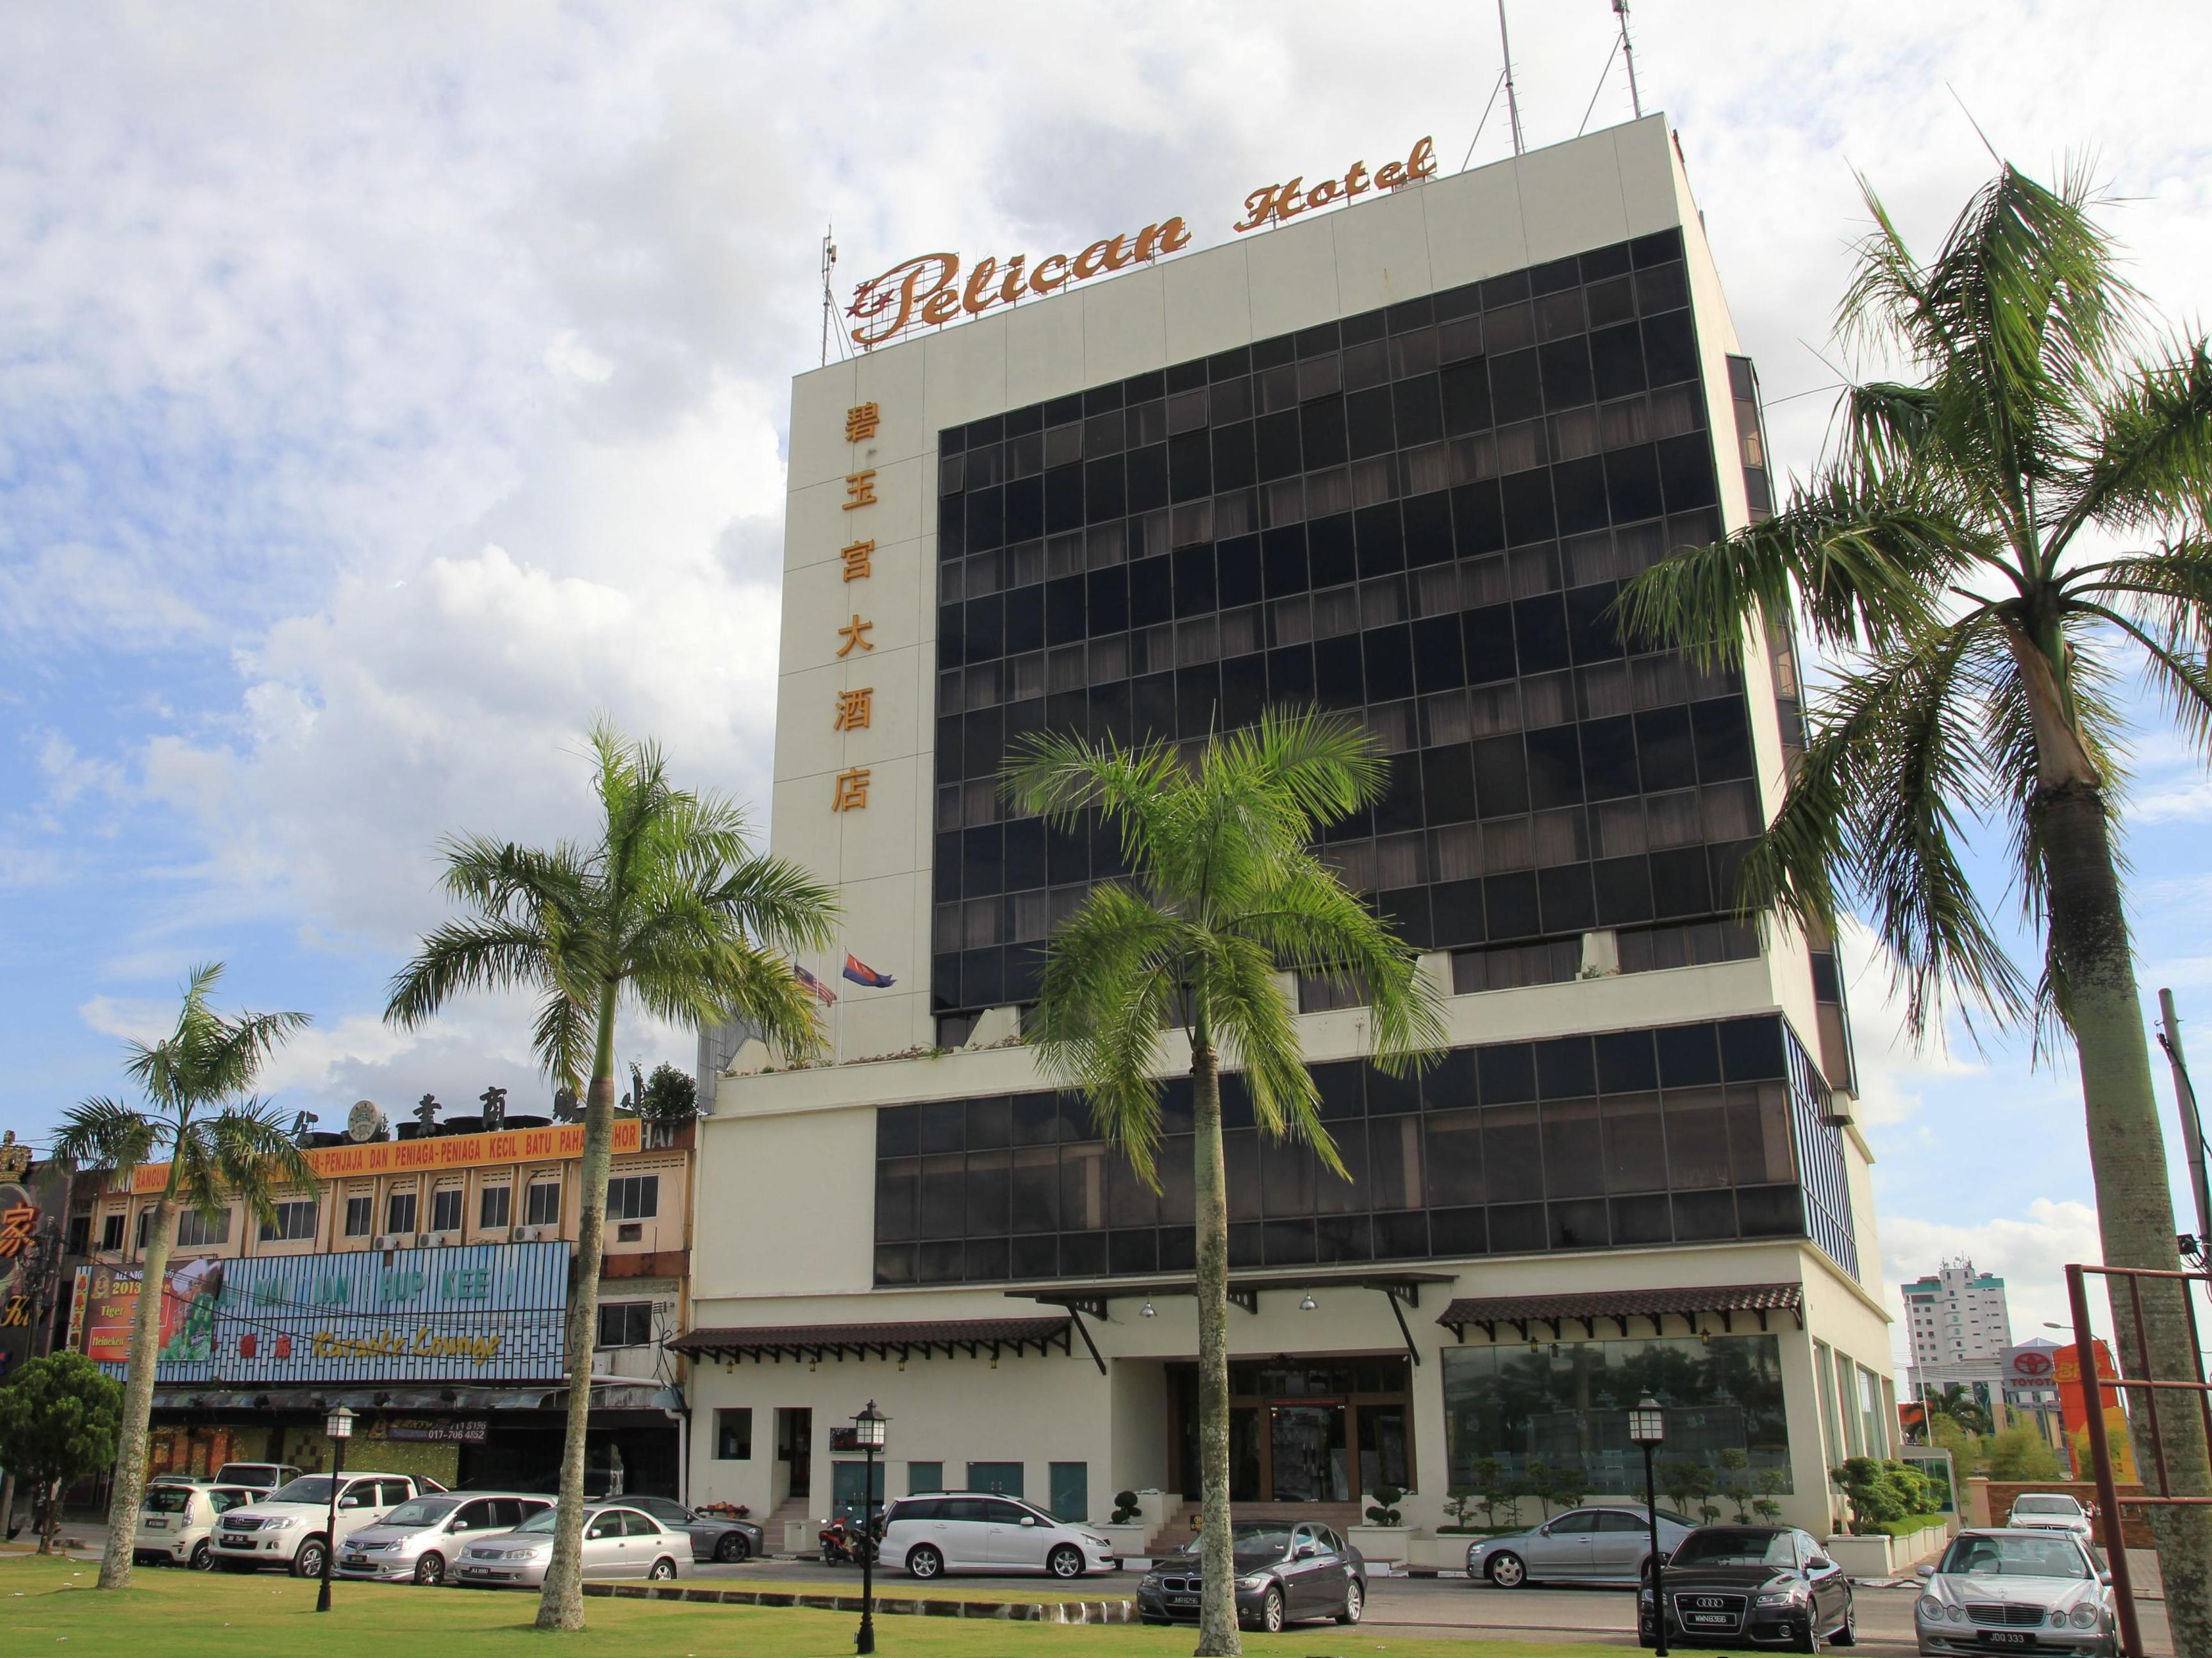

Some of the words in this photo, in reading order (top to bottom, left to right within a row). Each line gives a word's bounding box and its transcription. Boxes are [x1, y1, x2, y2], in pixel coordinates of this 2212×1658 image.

[851, 216, 1192, 344] Pelican
[1233, 135, 1438, 233] Hotel
[369, 1148, 388, 1169] DAN
[395, 1140, 481, 1167] PENIAGA-PENIAGA
[489, 1136, 517, 1159] KECIL
[526, 1132, 551, 1155] BATU
[560, 1129, 585, 1152] PAHA
[380, 1270, 426, 1302] HUP
[442, 1268, 490, 1299] KEE
[101, 1305, 124, 1318] Tiger
[313, 1328, 406, 1357] Karaoke
[412, 1327, 501, 1366] Lounge
[2007, 1634, 2025, 1643] 333
